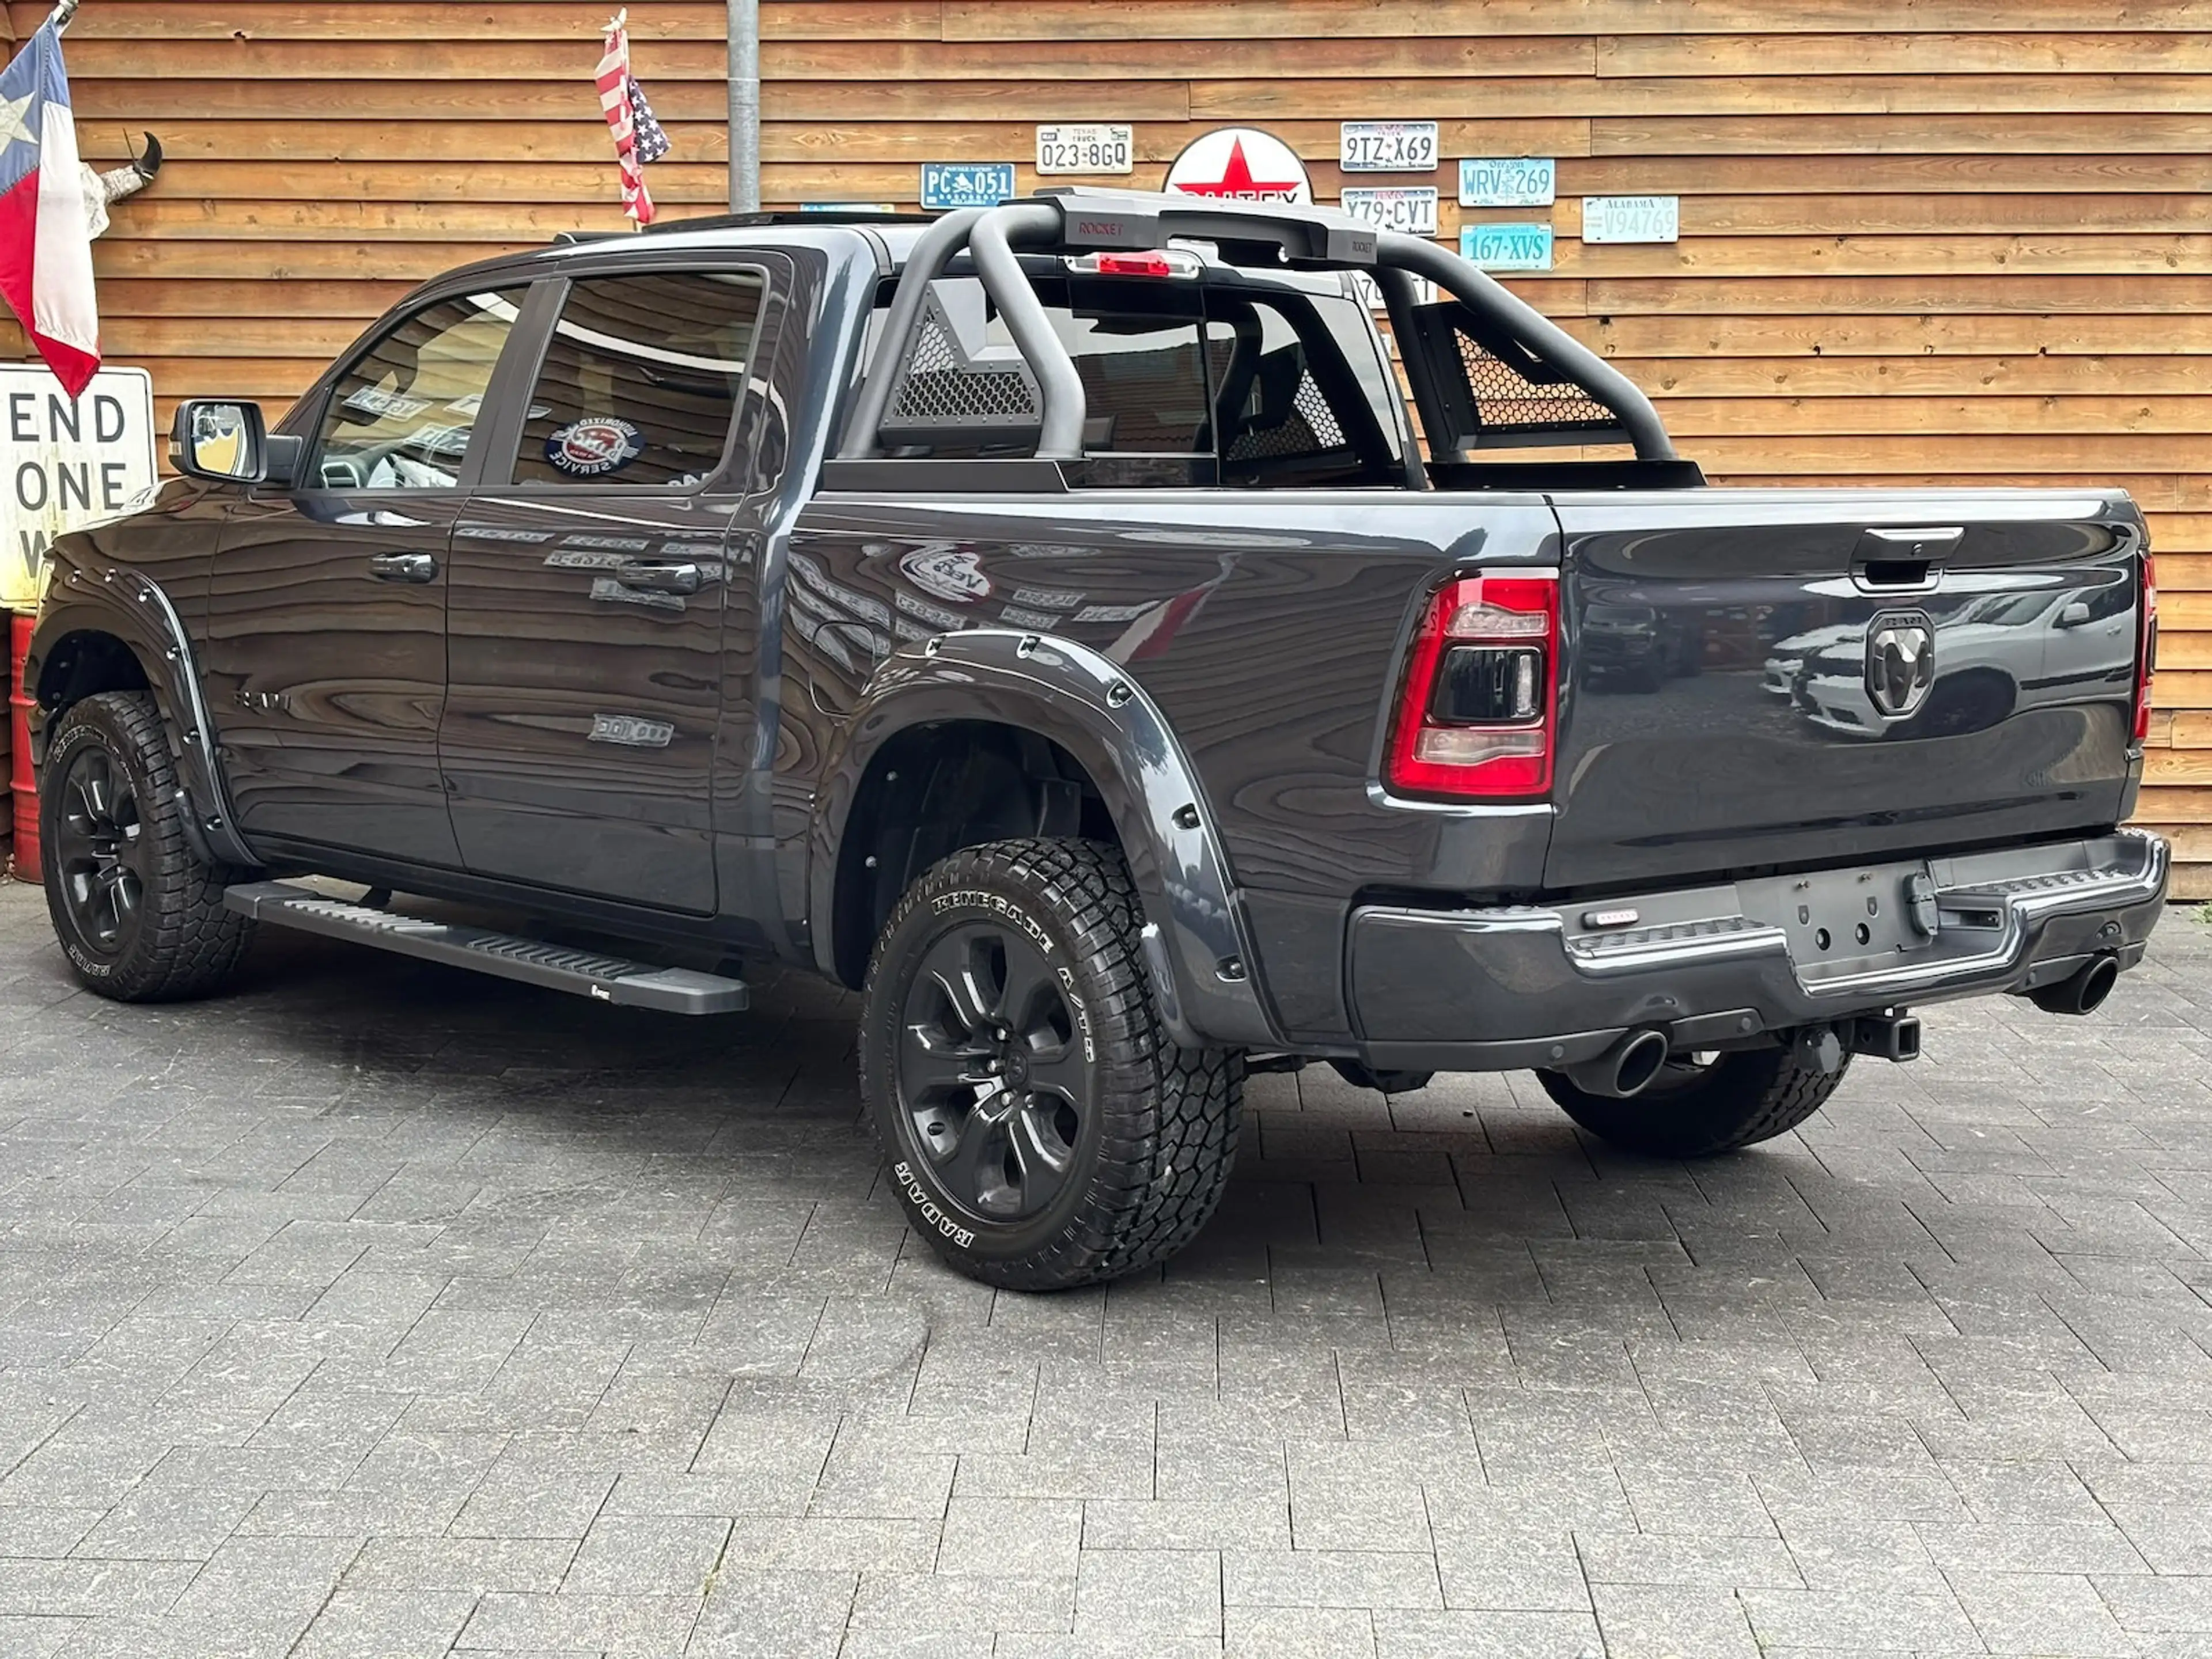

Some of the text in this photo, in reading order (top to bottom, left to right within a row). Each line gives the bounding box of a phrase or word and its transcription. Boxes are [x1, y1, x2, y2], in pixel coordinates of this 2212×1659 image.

[1080, 222, 1123, 236] ROCKET
[1605, 210, 1676, 234] V94769
[9, 393, 125, 442] END
[16, 461, 126, 511] ONE
[931, 890, 1054, 954] RENEGADE
[894, 1161, 975, 1248] RADAR
